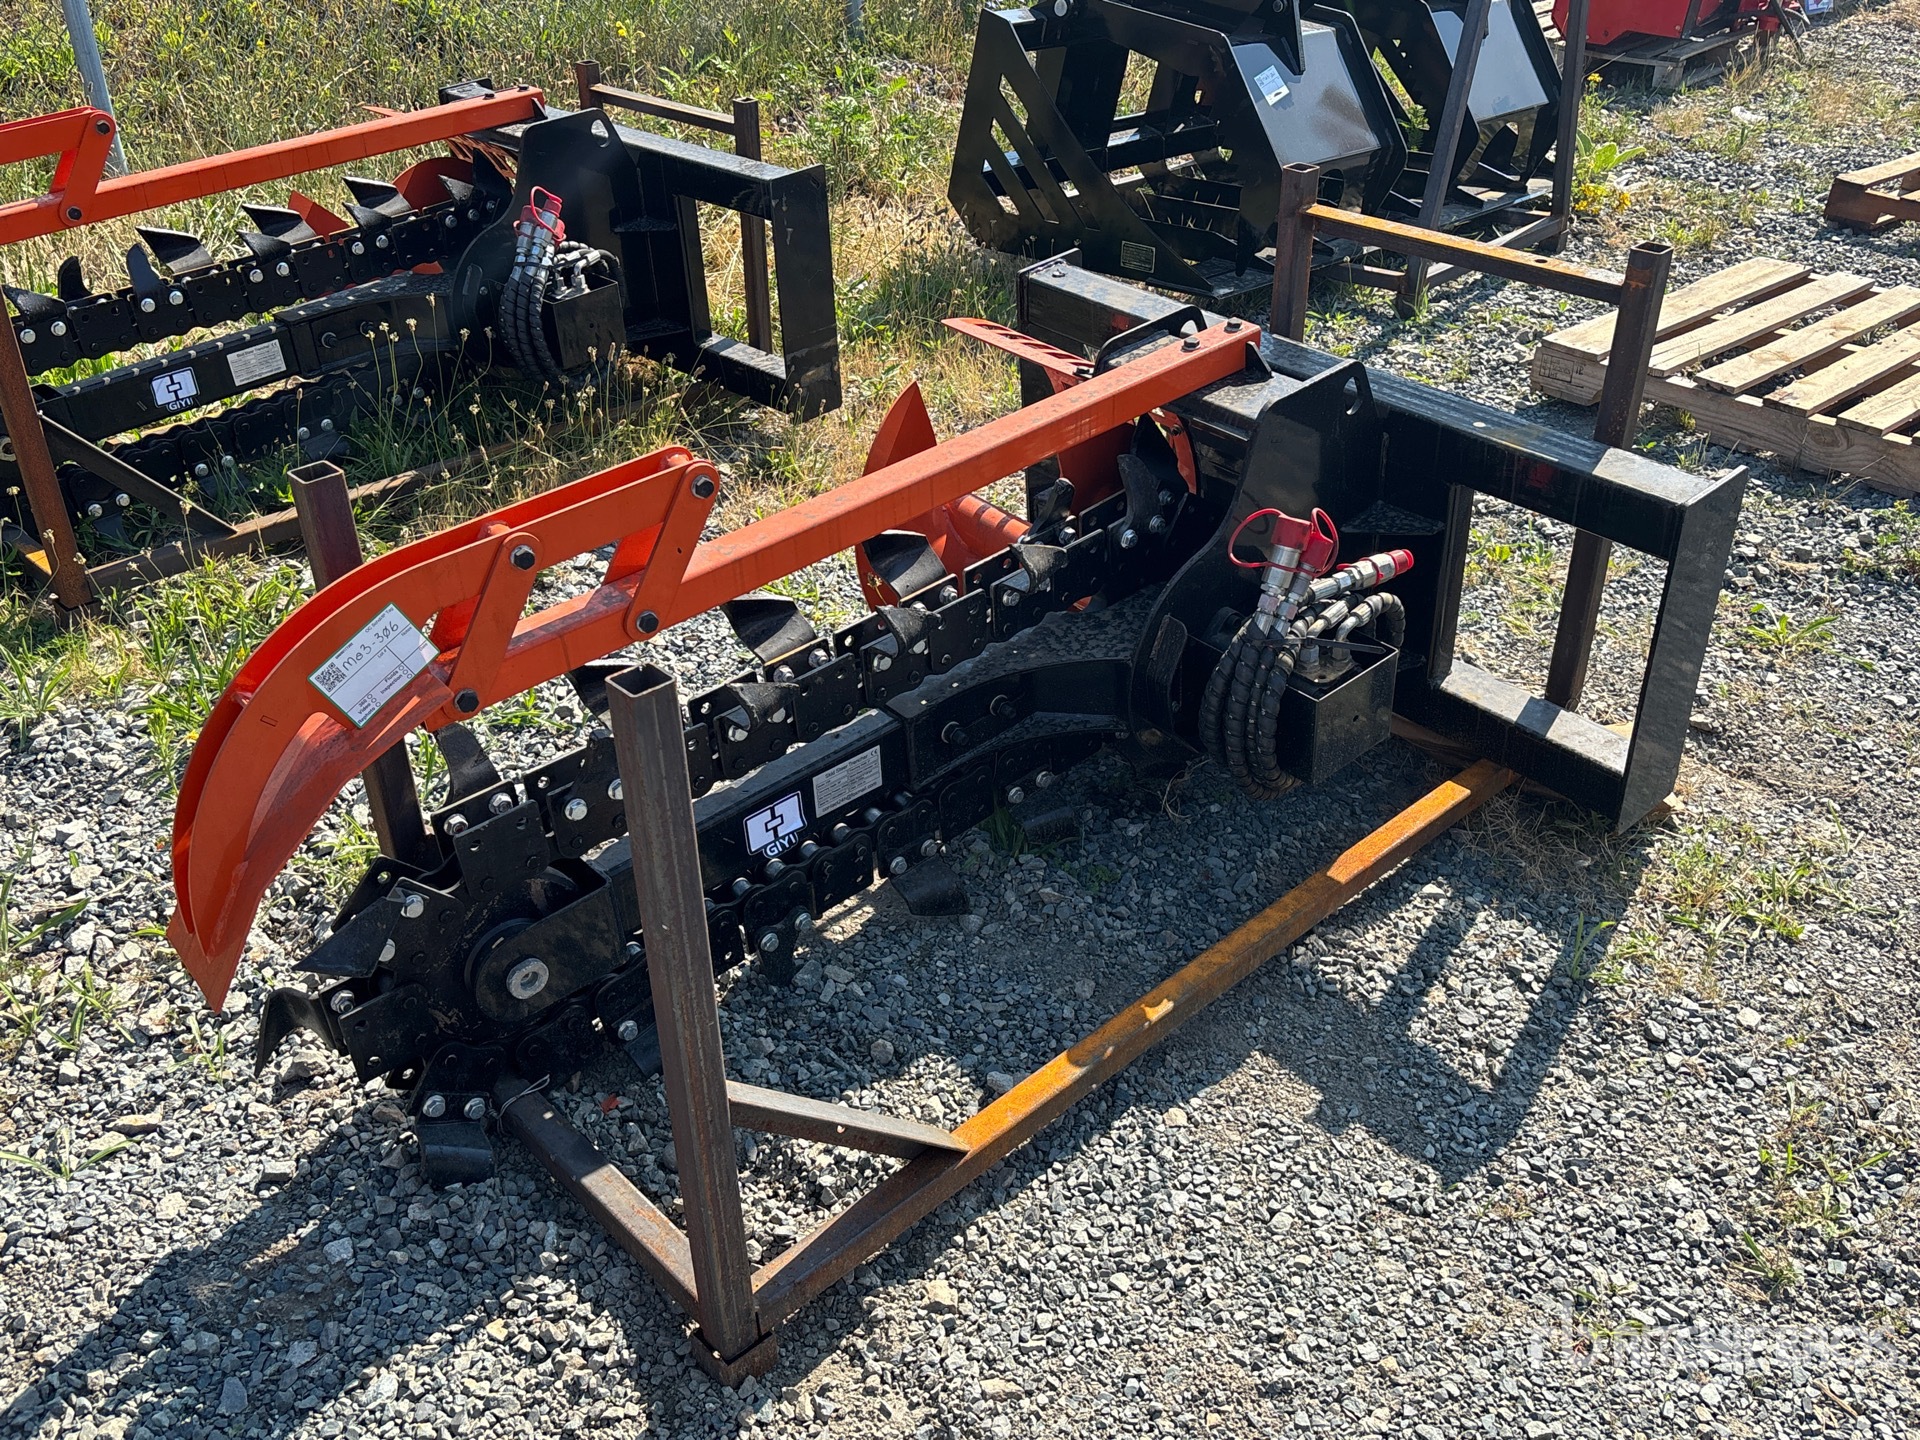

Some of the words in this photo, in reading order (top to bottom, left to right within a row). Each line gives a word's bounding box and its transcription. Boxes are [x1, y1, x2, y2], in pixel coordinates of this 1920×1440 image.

[168, 398, 193, 411] GIYI
[380, 674, 403, 694] Inspection
[358, 703, 371, 714] Video
[766, 834, 796, 857] GIYI
